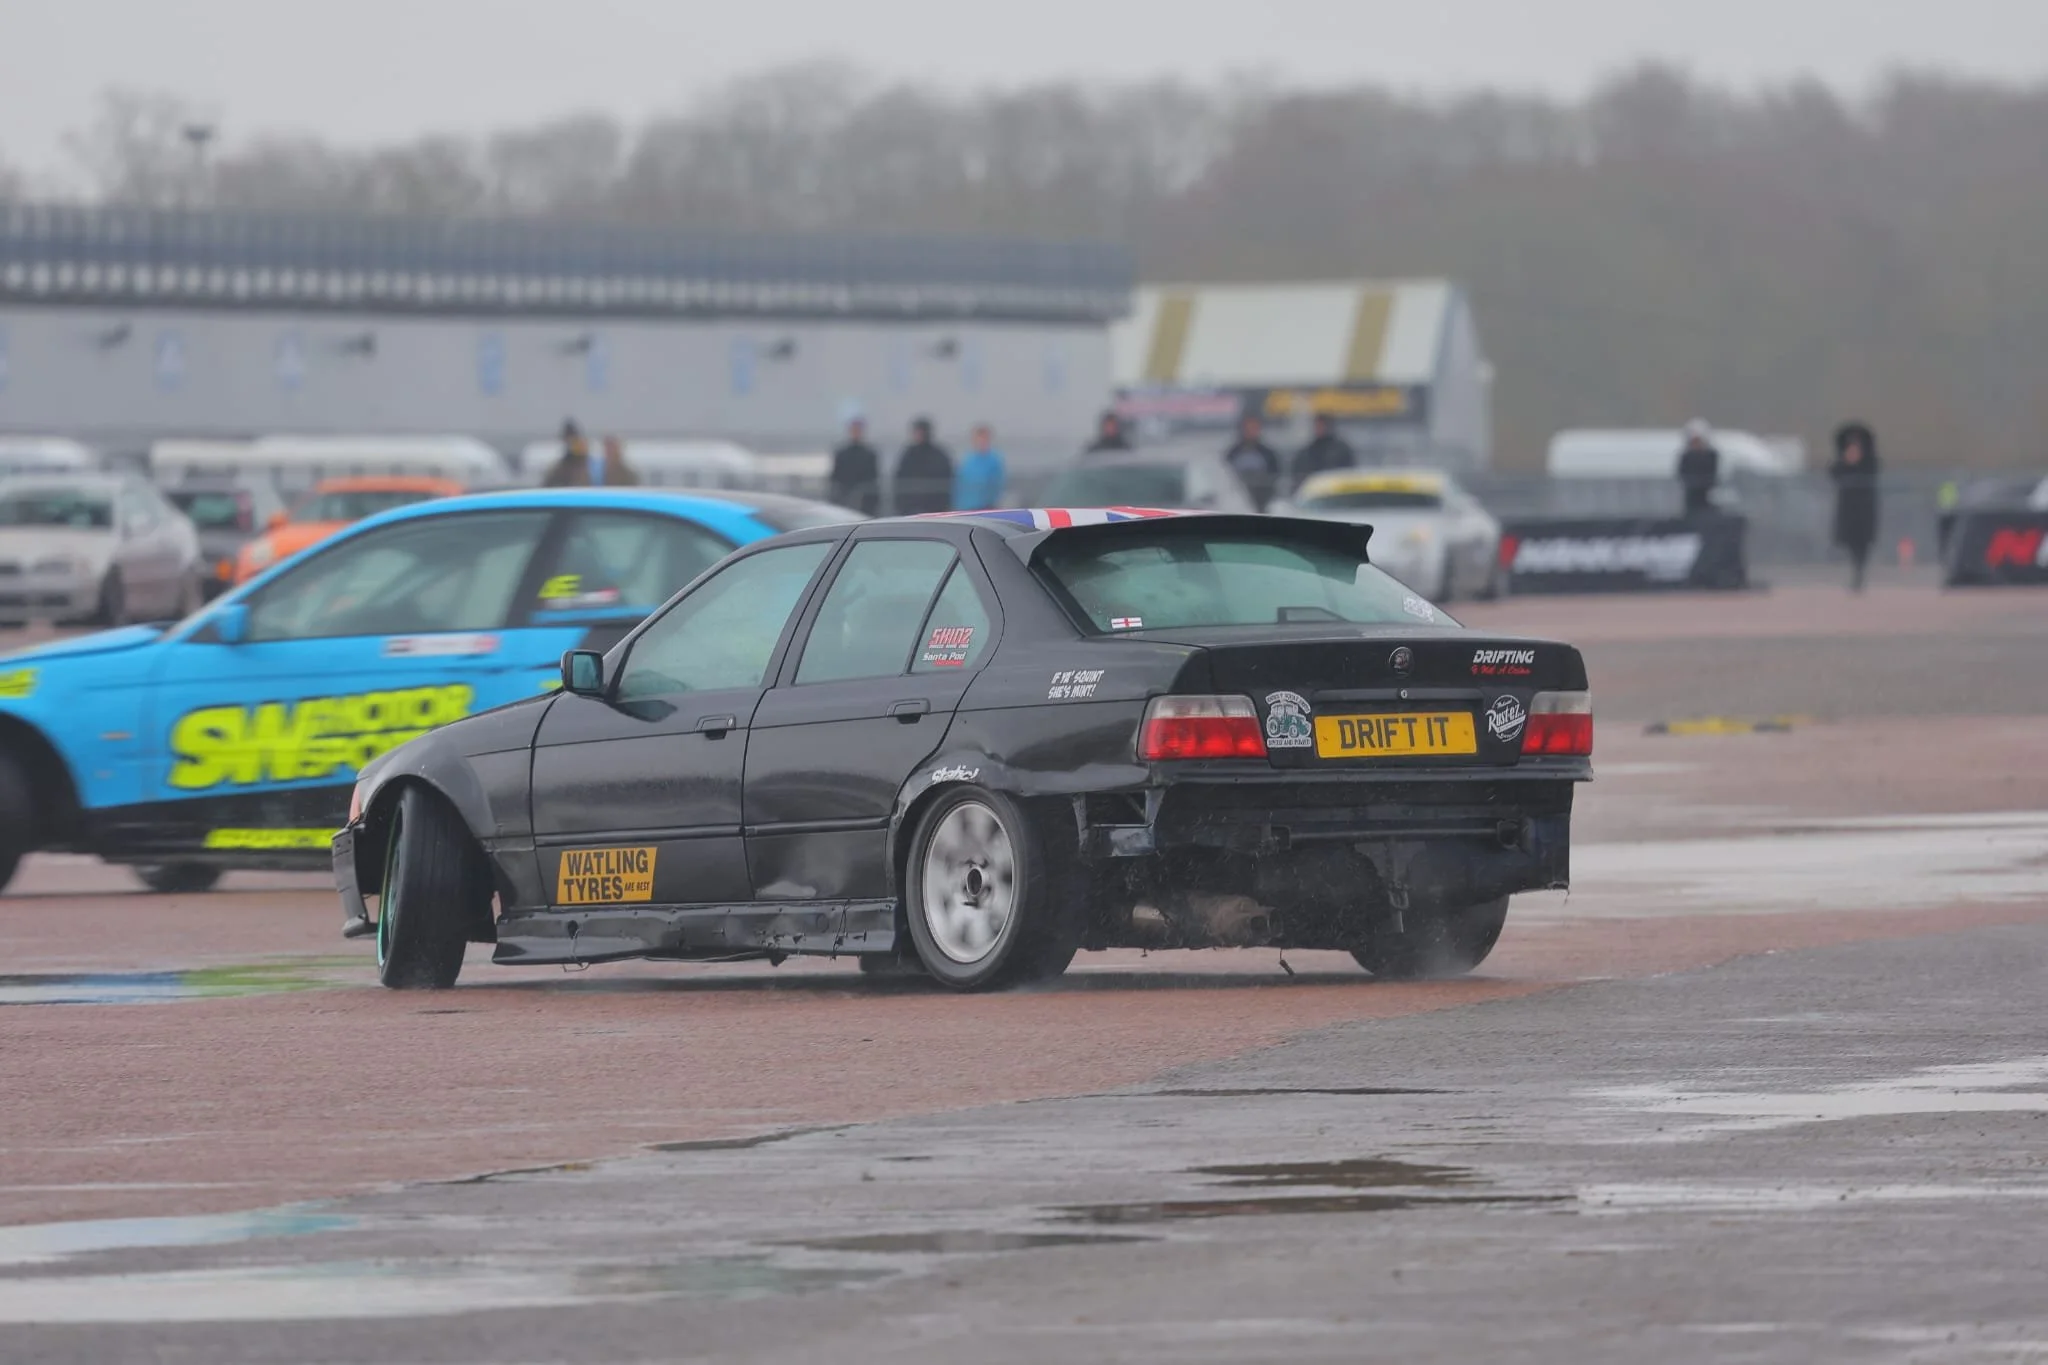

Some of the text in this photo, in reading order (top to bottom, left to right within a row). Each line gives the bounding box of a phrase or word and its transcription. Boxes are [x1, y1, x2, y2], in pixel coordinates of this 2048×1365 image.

[922, 651, 967, 661] Santa Pod
[1473, 649, 1535, 664] DRIFTING
[1073, 669, 1105, 684] SQUINT
[1047, 683, 1097, 699] SHE'S MINT!
[1337, 717, 1449, 749] DRIFT IT
[566, 849, 649, 876] WATLING
[563, 876, 624, 902] TYRES
[624, 882, 635, 892] ARE
